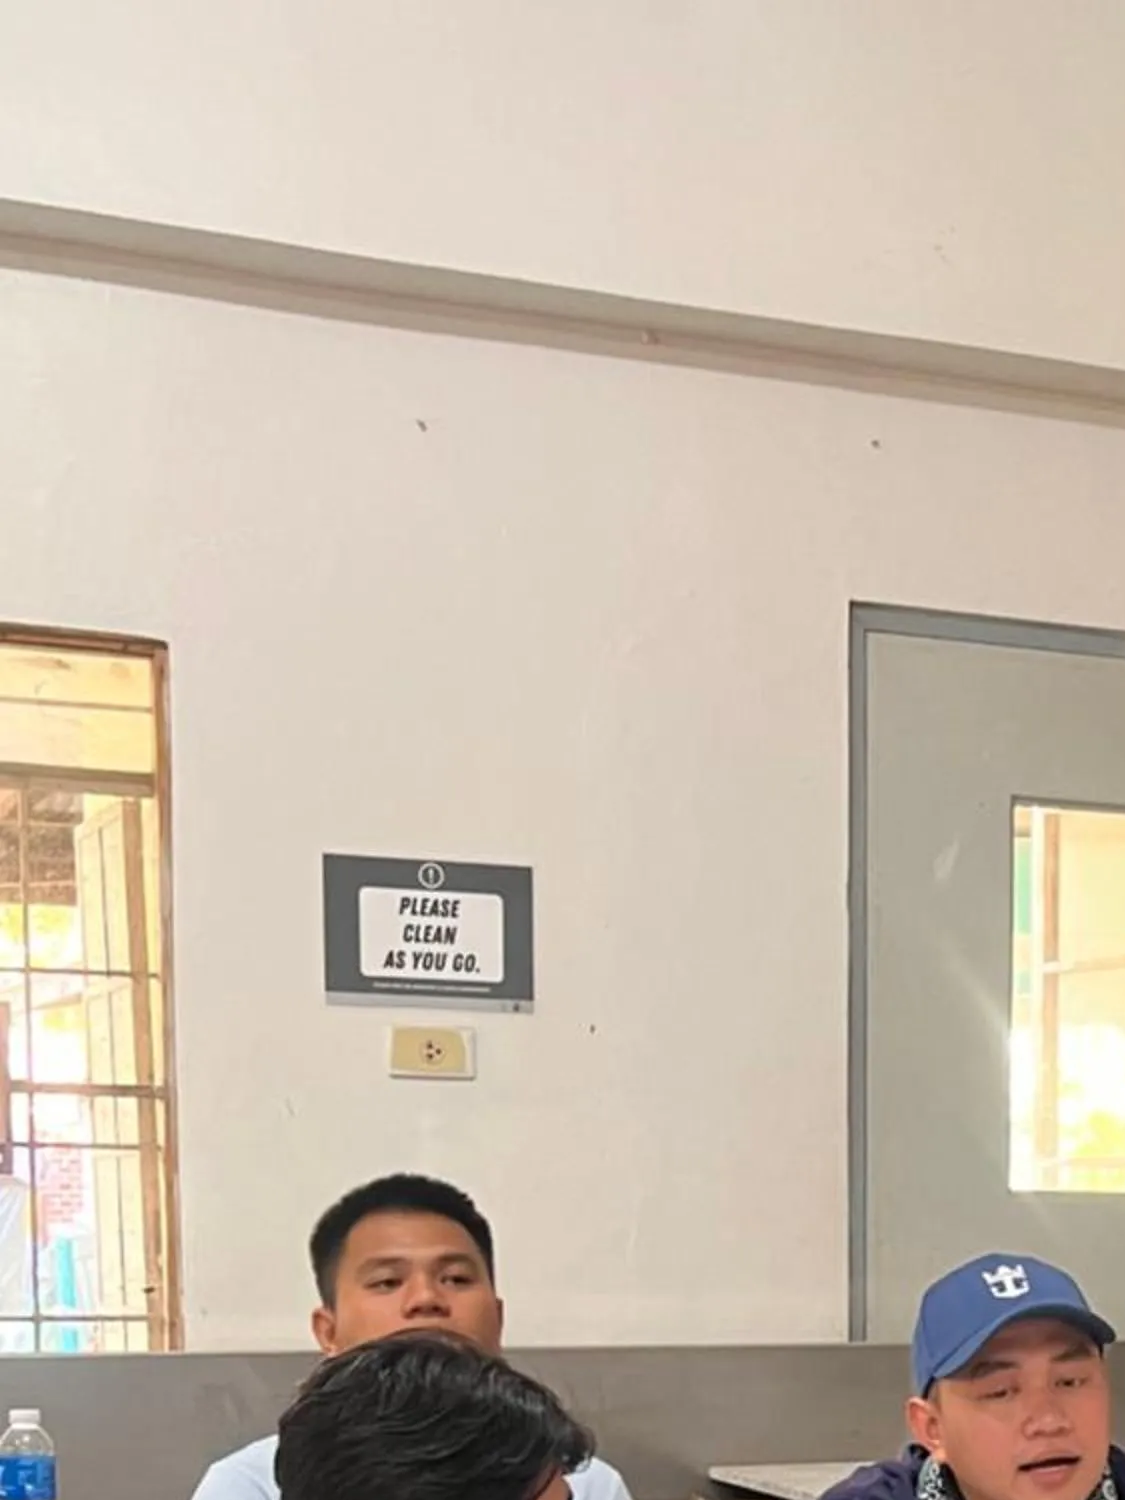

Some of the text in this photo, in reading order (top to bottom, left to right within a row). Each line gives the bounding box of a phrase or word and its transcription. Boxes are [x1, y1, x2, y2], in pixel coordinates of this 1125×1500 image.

[399, 897, 460, 918] PLEASE
[403, 924, 458, 945] CLEAN
[384, 950, 481, 974] AS YOU GO.
